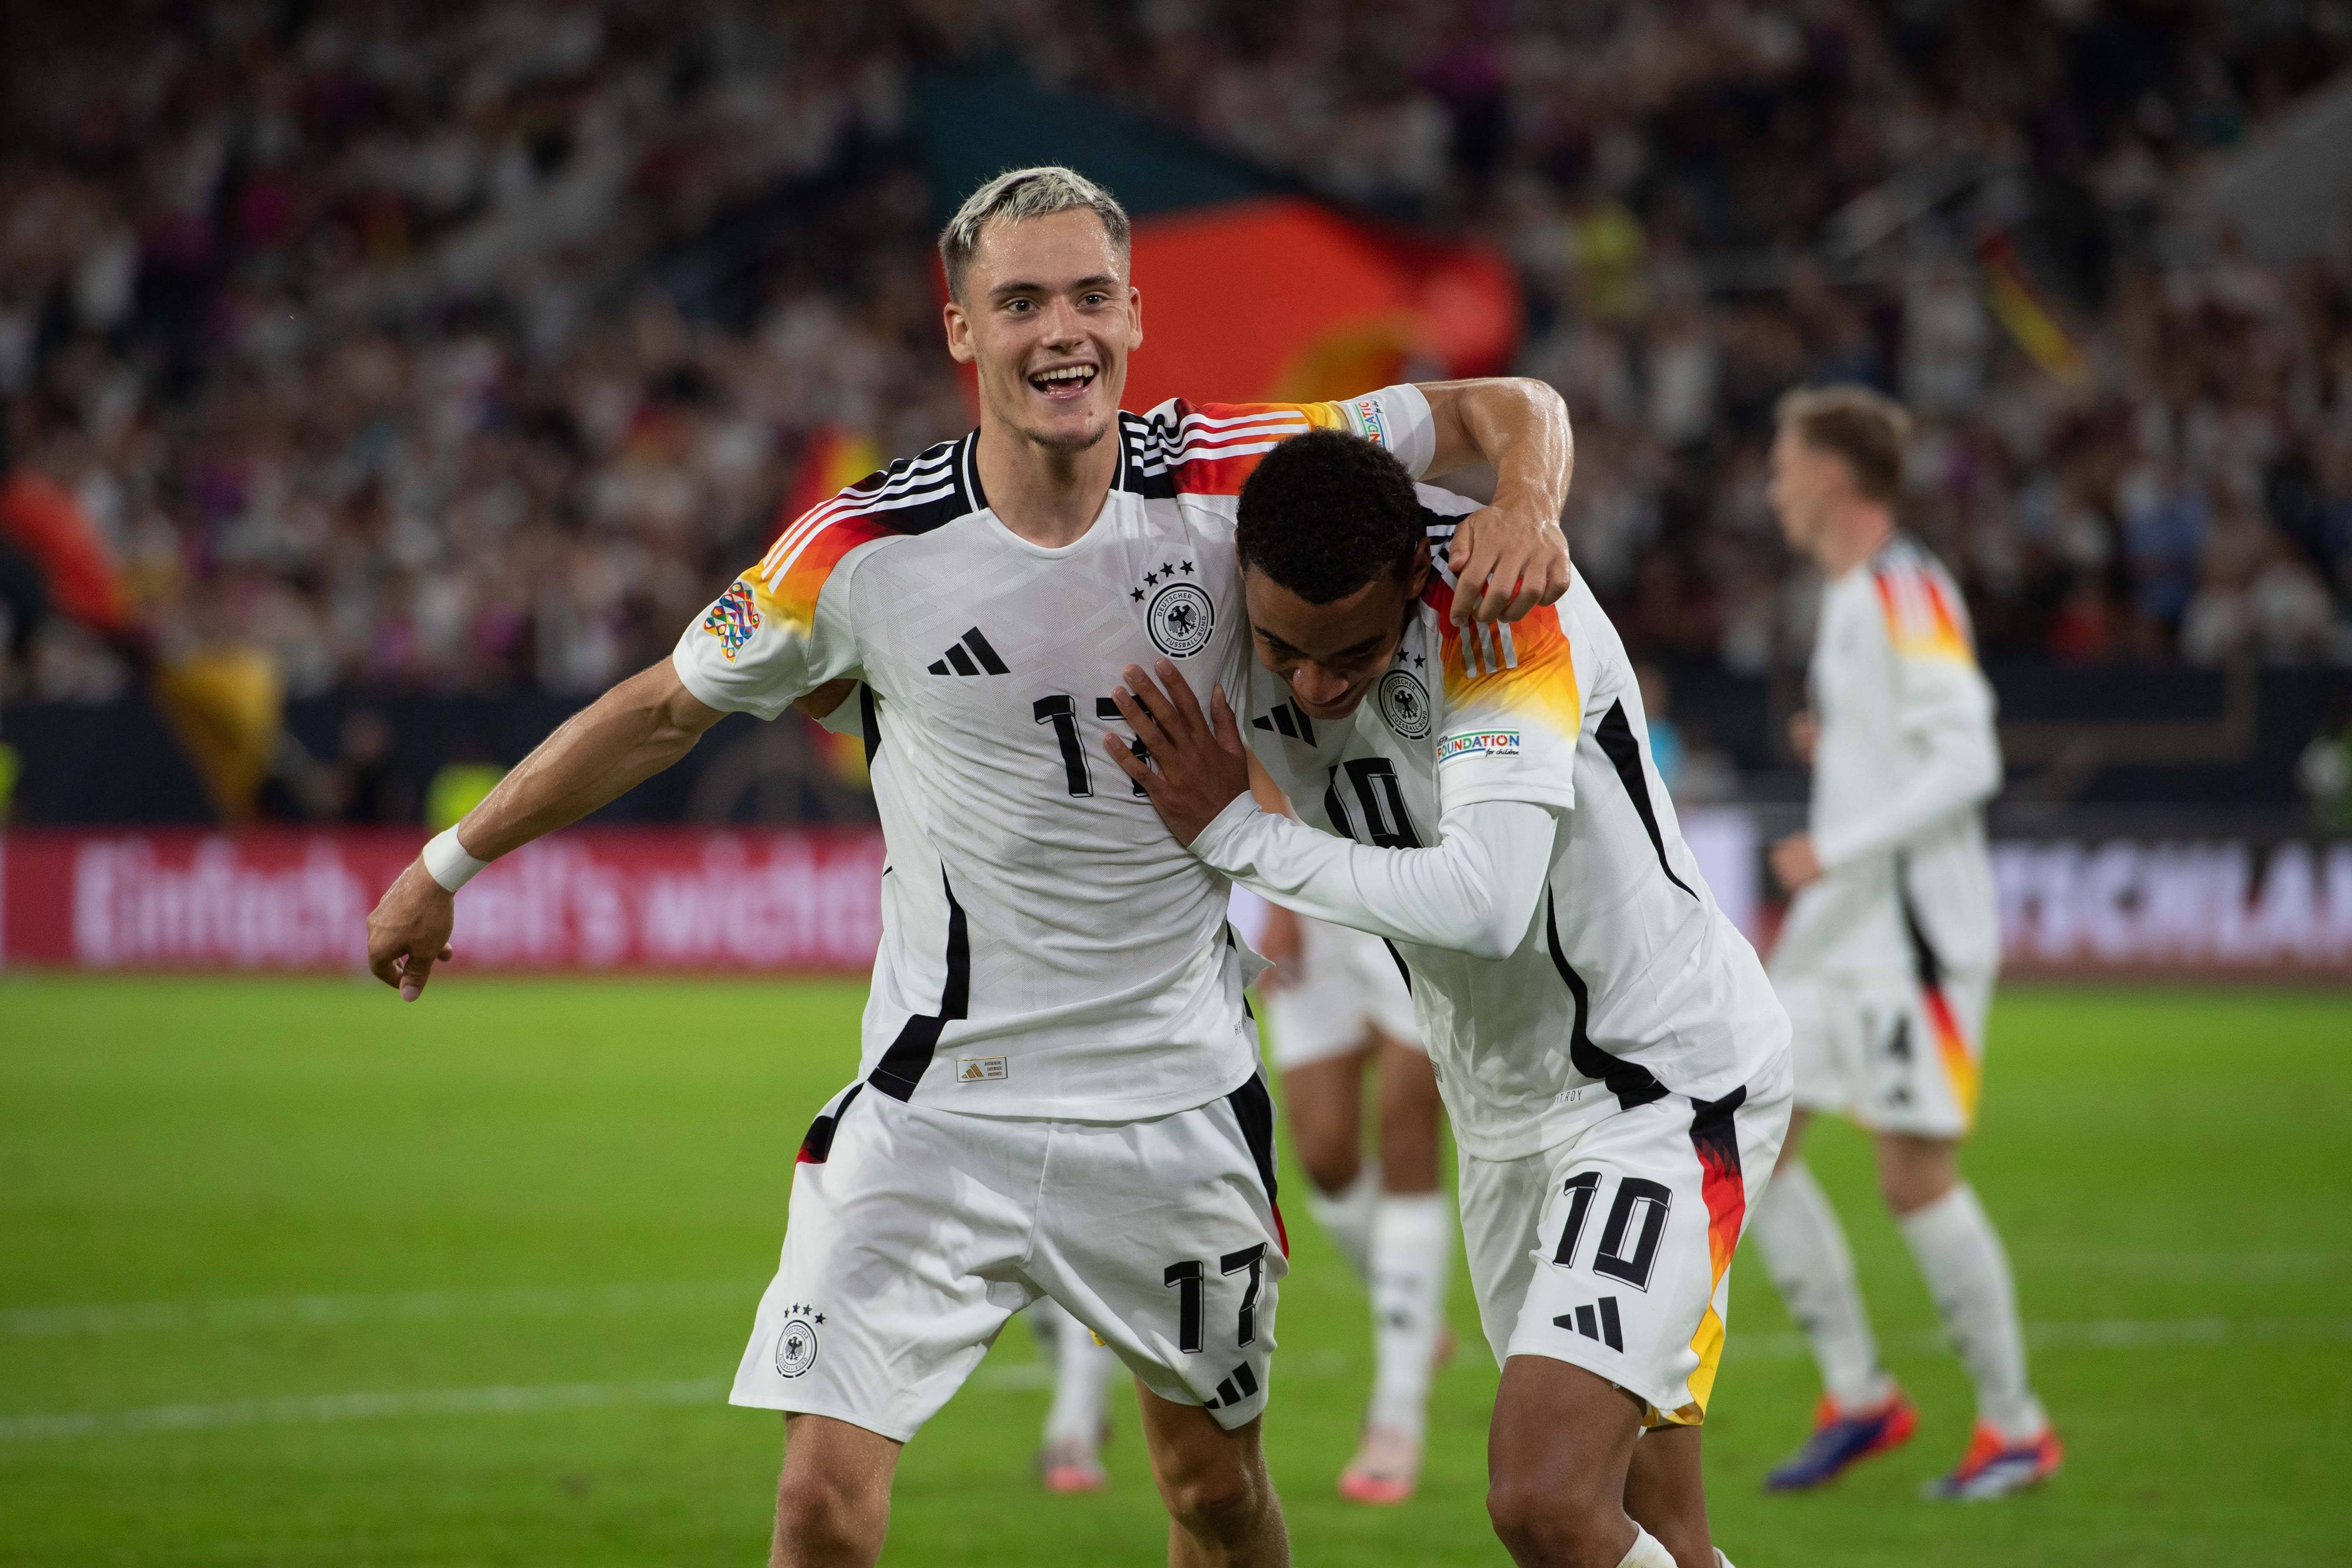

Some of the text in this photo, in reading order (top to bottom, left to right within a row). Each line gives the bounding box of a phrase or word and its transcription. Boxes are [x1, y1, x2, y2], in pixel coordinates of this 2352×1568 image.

[1358, 402, 1381, 443] NDATIO
[1157, 592, 1192, 617] DEUTSCHER
[1165, 616, 1207, 647] FUSSBALL-BUND
[1387, 678, 1415, 693] DEUTSCHER
[1391, 710, 1428, 731] FUSSBALL-BUND
[1485, 747, 1519, 757] for children
[1324, 757, 1426, 850] 10
[1552, 1171, 1673, 1293] 10
[1164, 1241, 1268, 1353] 17
[786, 1327, 809, 1340] DEUTSCHER
